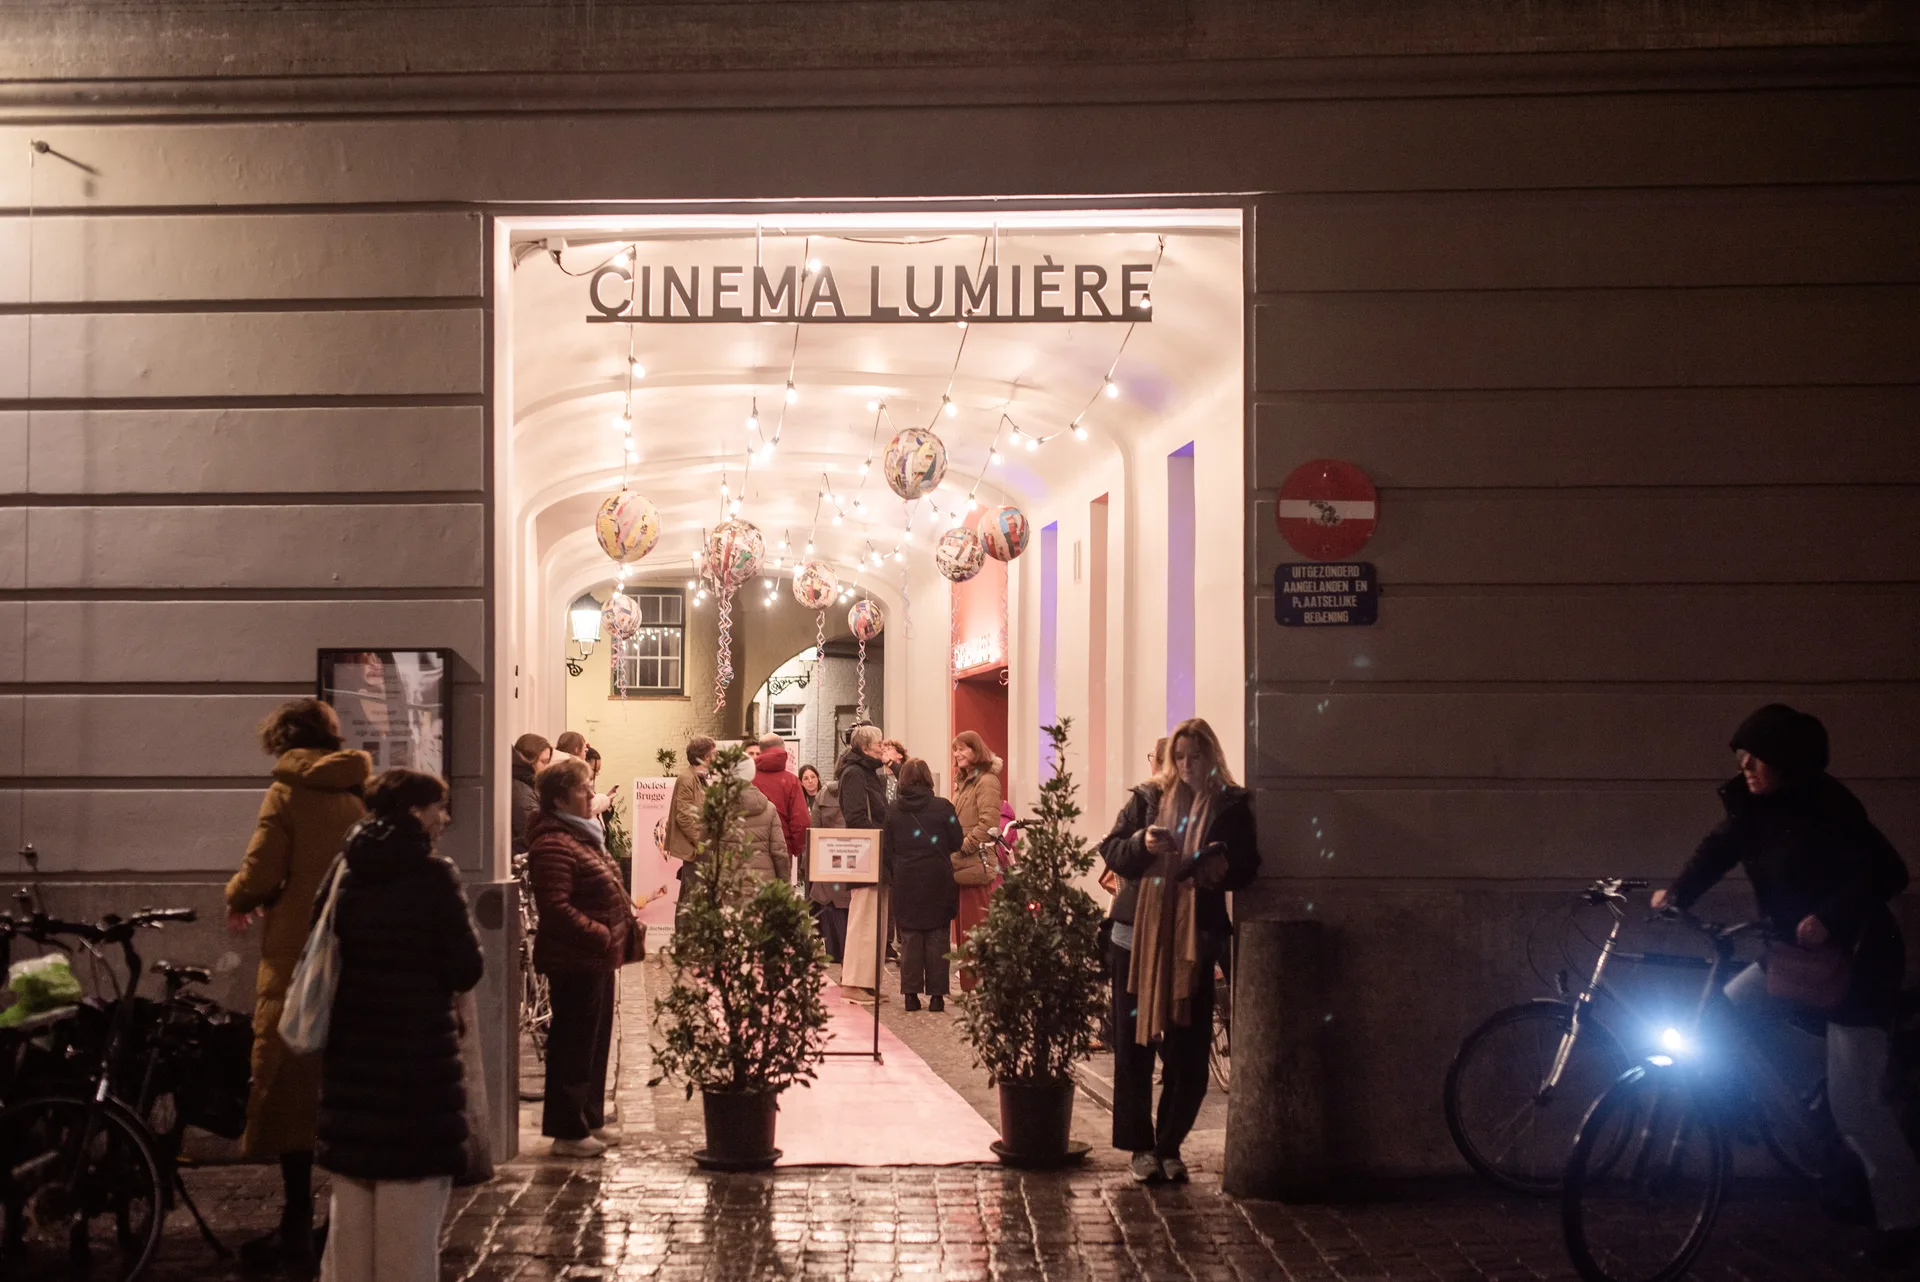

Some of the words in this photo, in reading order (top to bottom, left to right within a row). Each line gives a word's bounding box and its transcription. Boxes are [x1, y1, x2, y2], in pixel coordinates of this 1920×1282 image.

[589, 265, 847, 318] CINEMA
[870, 255, 1153, 318] LUMIÈRE
[1292, 566, 1359, 578] UITGEZONDERD
[1284, 580, 1348, 593] AANGELANDEN
[1355, 580, 1367, 591] EN
[1292, 595, 1357, 607] PLAATSELIJKE
[636, 781, 666, 789] Docfest
[636, 792, 665, 802] Brugge
